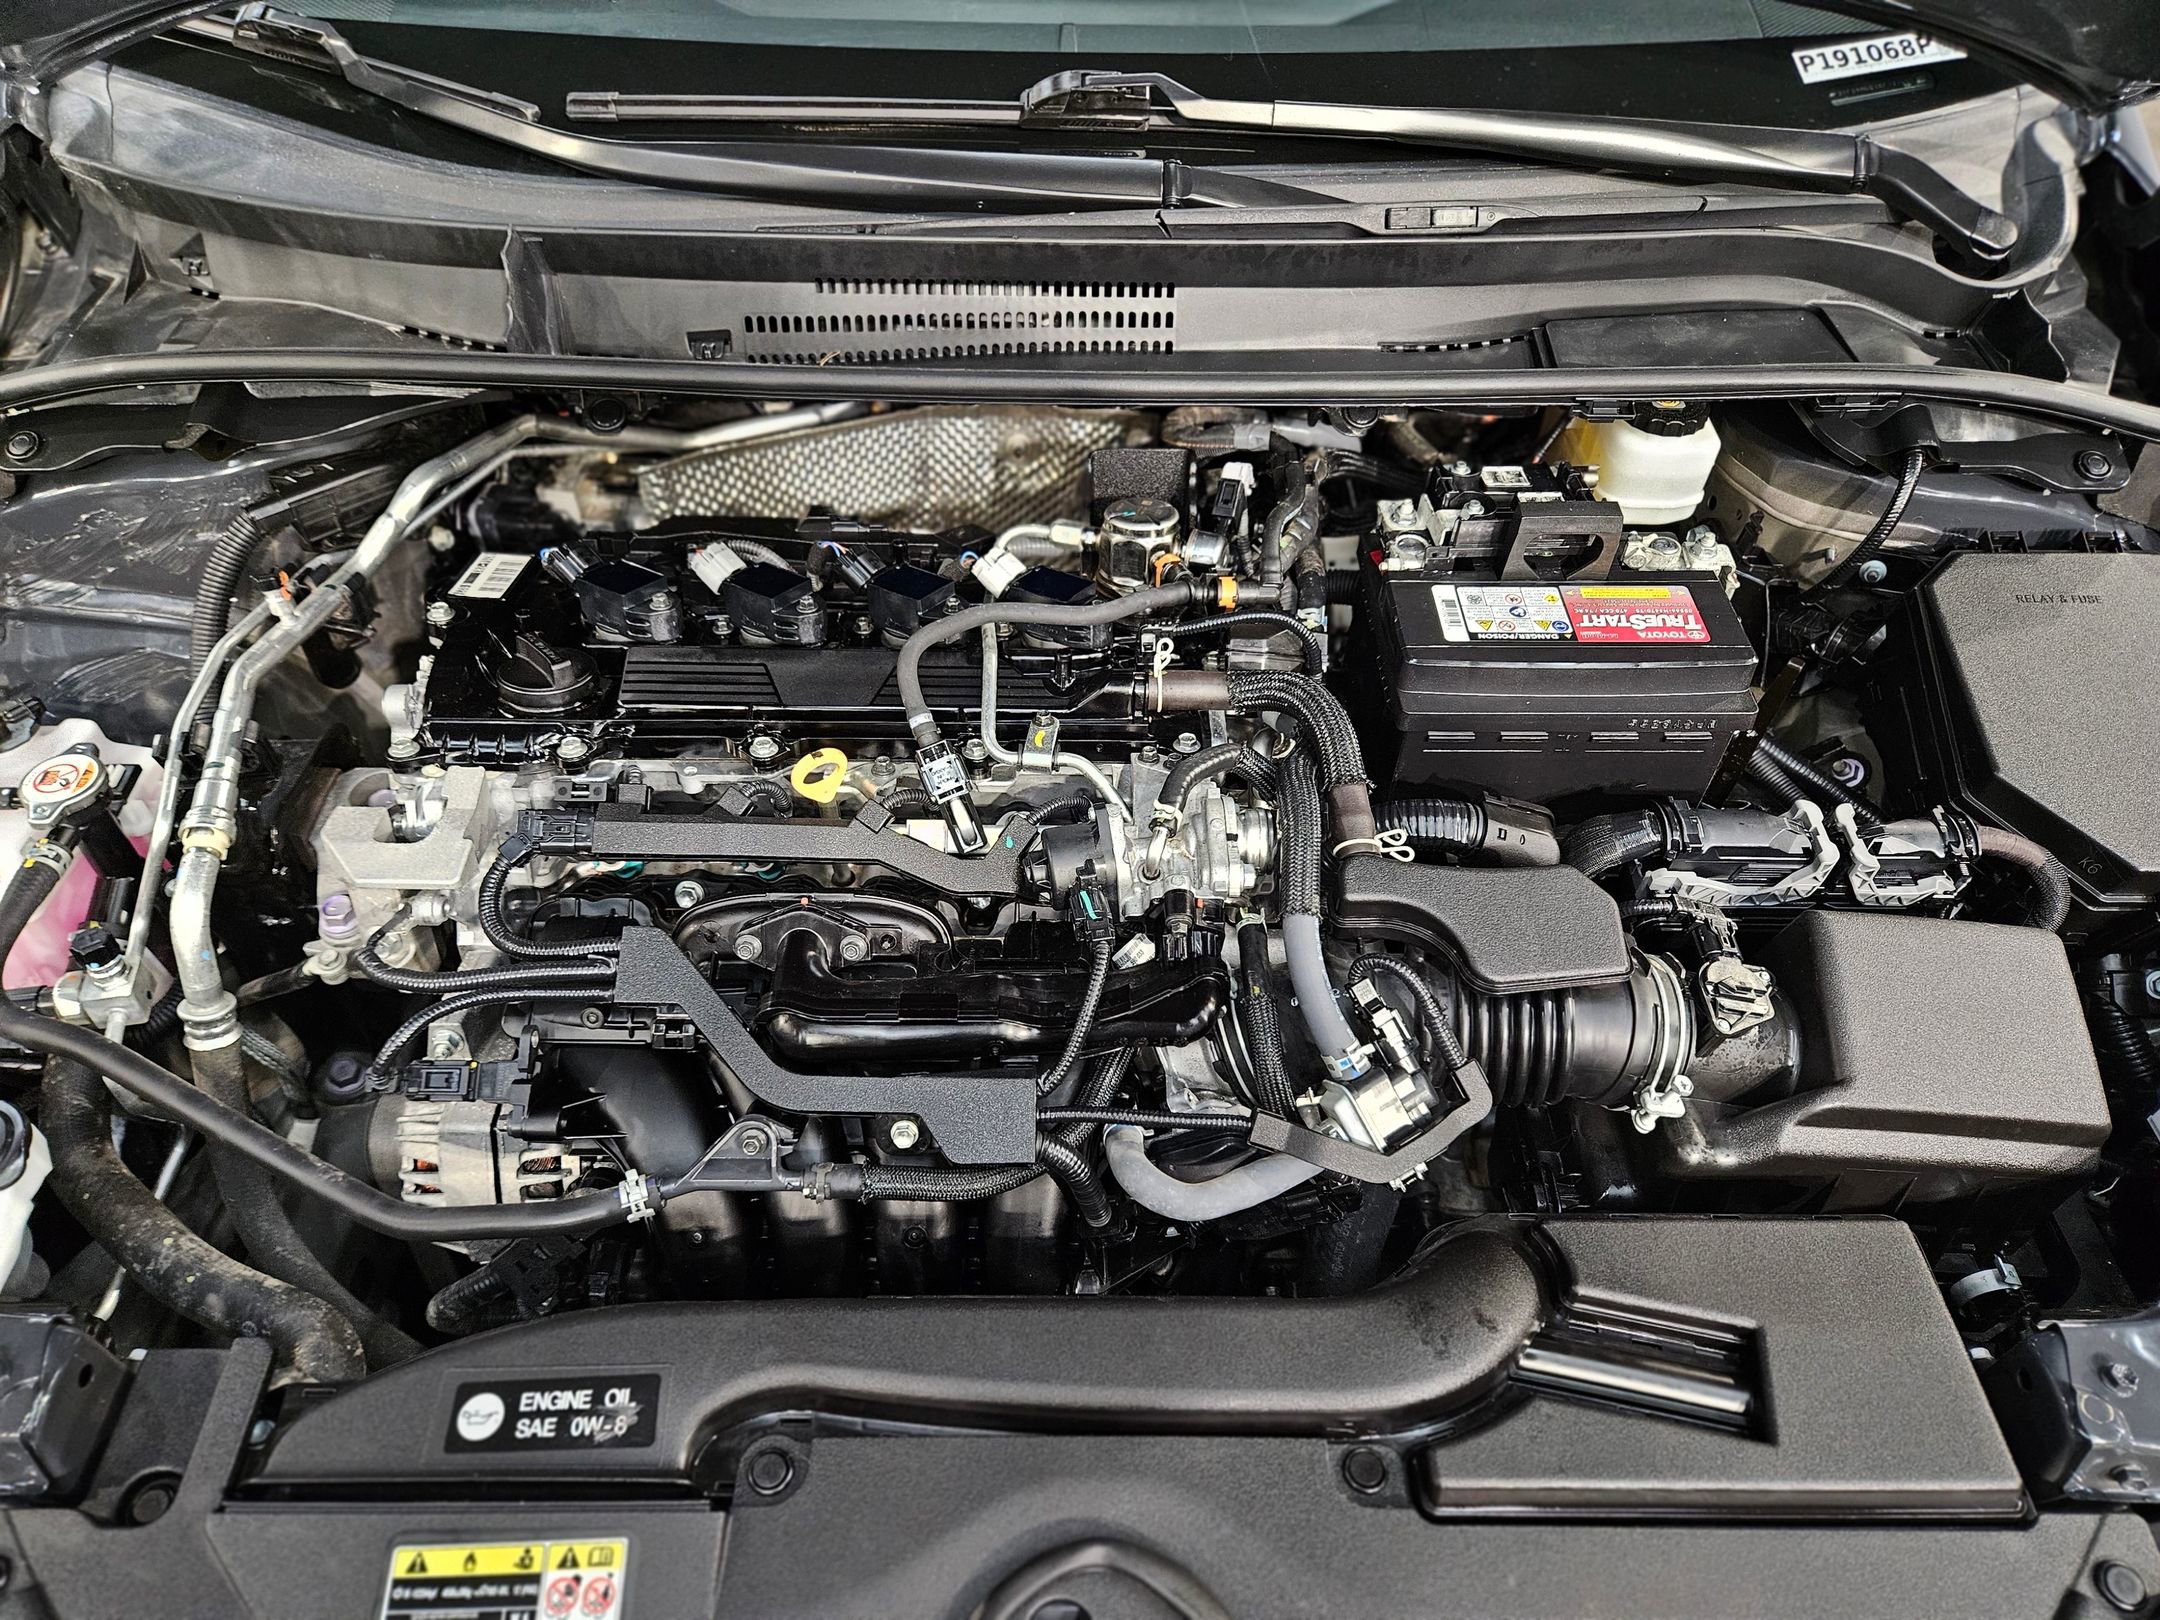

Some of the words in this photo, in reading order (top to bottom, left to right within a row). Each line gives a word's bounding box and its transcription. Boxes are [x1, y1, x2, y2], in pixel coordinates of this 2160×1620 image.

[2016, 594, 2054, 603] RELAY
[2059, 594, 2067, 603] &
[2071, 594, 2102, 603] FUSE
[1637, 631, 1686, 639] TOYOTA
[518, 1389, 593, 1412] ENGINE
[604, 1387, 637, 1408] OIL
[514, 1416, 557, 1438] SAE
